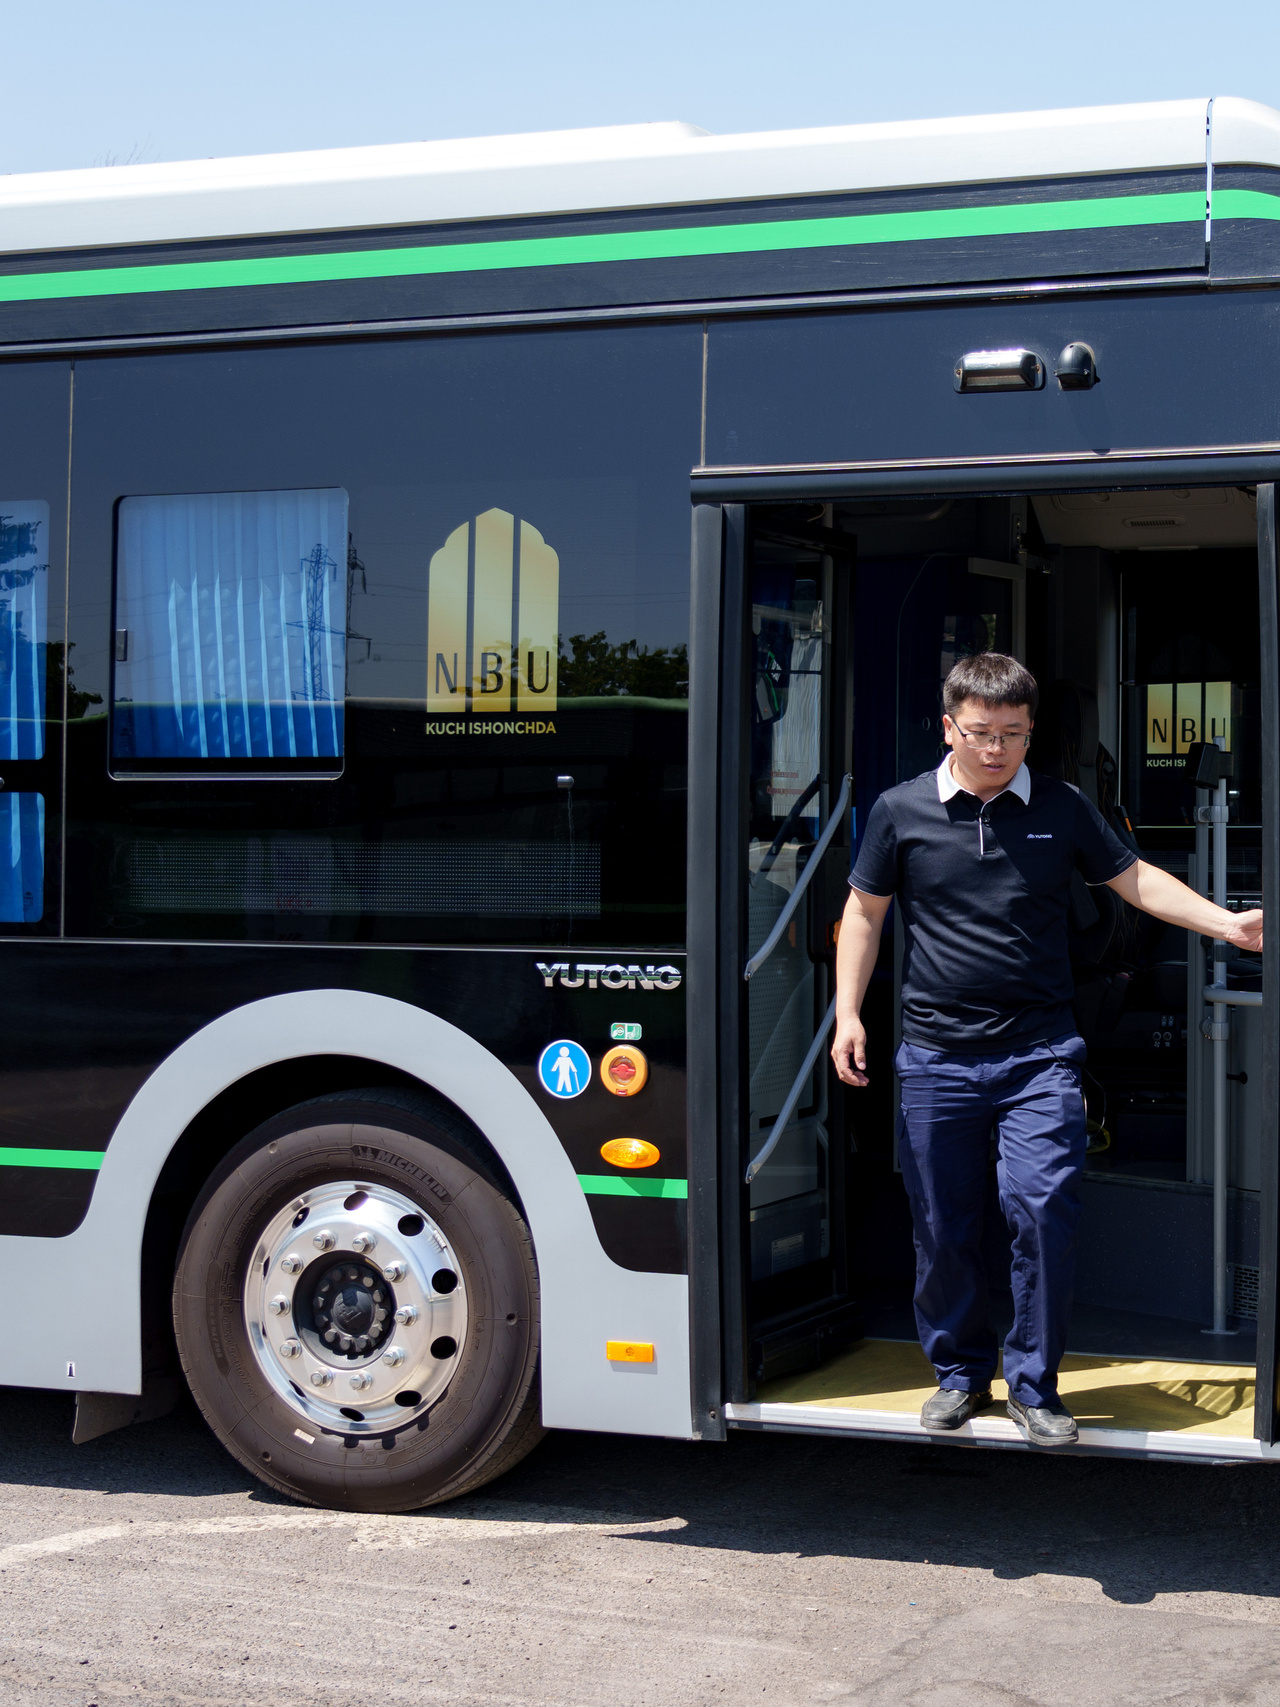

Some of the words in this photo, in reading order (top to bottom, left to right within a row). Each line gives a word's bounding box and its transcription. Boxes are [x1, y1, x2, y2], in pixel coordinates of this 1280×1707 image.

[435, 651, 550, 694] NBU
[425, 722, 466, 735] KUCH
[468, 721, 557, 735] ISHONCHDA
[1146, 759, 1173, 767] KUCH
[536, 961, 682, 990] YUTONG
[375, 1151, 448, 1198] MICHELIN
